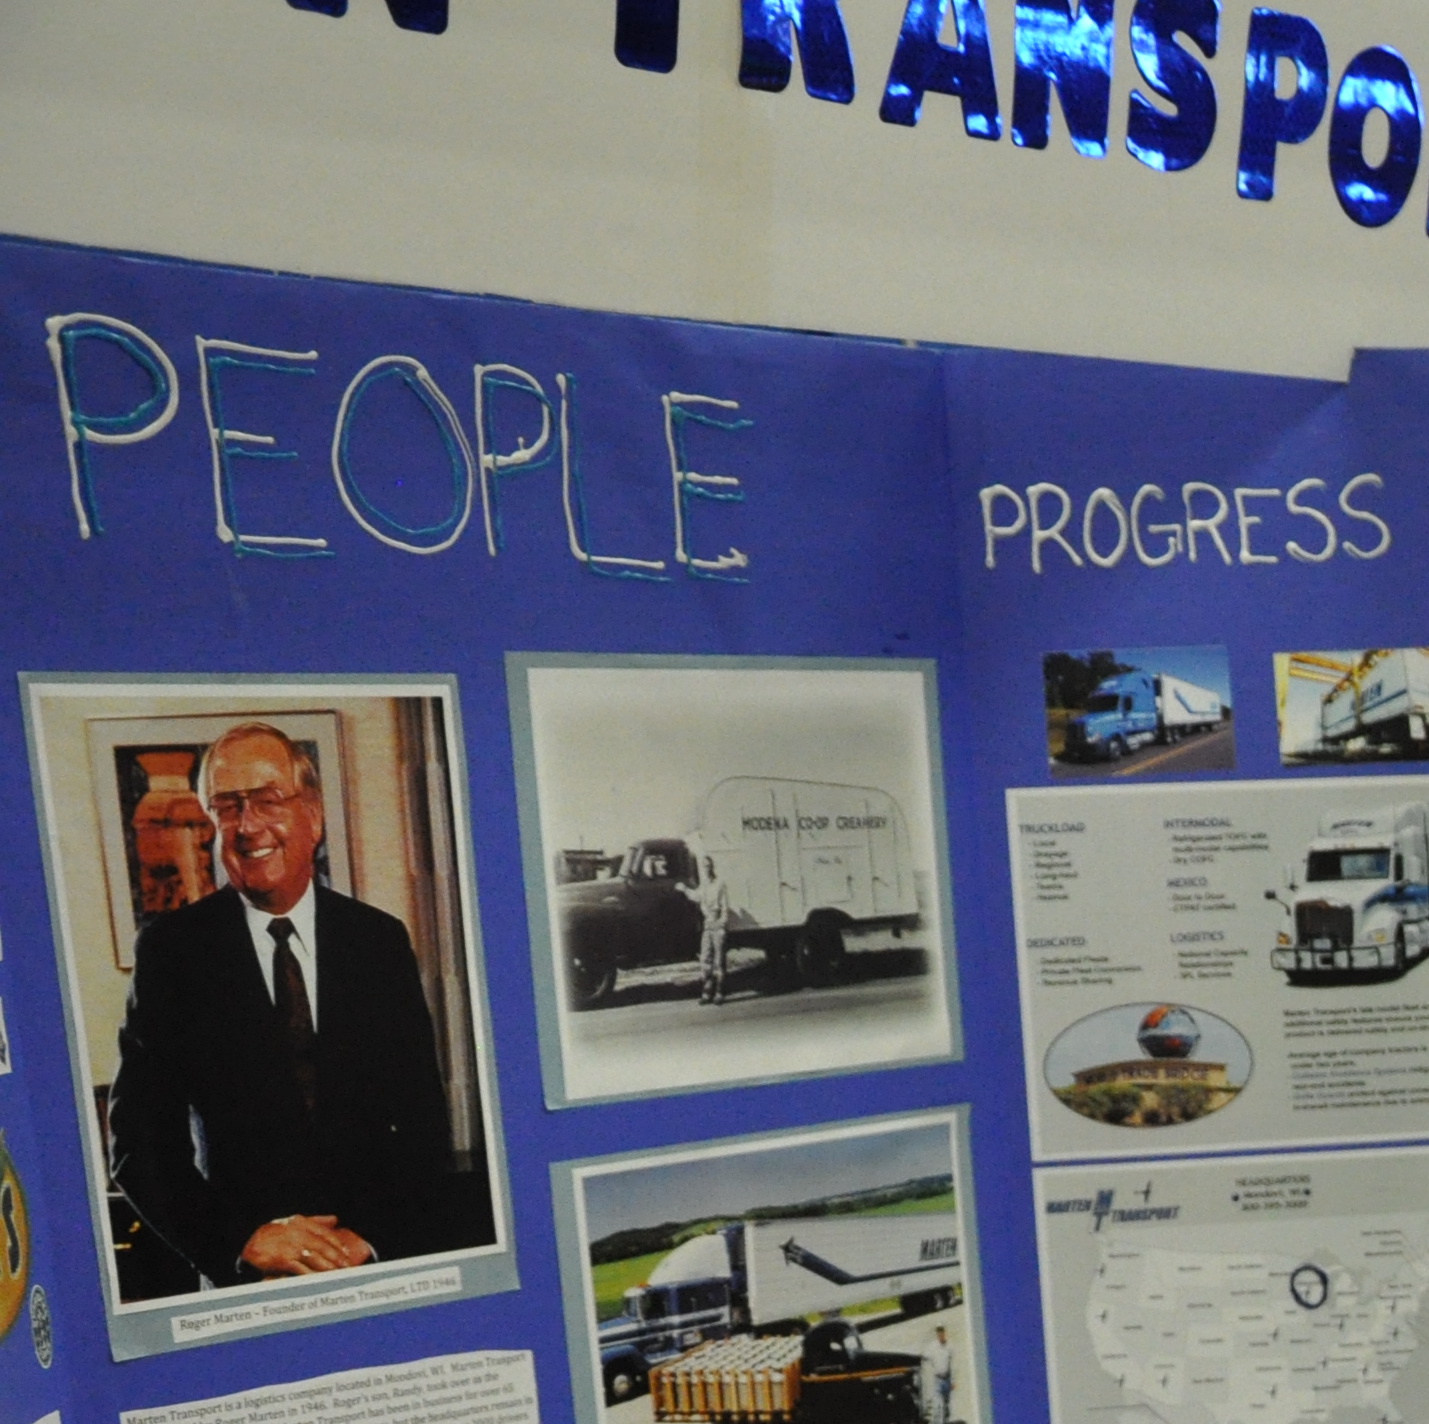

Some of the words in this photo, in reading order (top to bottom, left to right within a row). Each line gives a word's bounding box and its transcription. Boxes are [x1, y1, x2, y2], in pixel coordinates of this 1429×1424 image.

[46, 313, 754, 584] PEOPLE
[979, 473, 1393, 573] PROGRESS
[179, 1318, 210, 1330] Roger
[214, 1311, 251, 1323] Marten
[262, 1303, 304, 1316] Founder
[308, 1300, 317, 1308] of
[320, 1295, 355, 1305] Marten
[170, 1404, 221, 1420] Transport
[224, 1403, 233, 1411] is
[235, 1401, 242, 1409] a
[244, 1394, 285, 1408] logistics
[288, 1386, 332, 1400] company
[335, 1378, 370, 1391] located
[248, 1410, 284, 1421] Marten
[287, 1408, 297, 1416] in
[317, 1411, 365, 1424] Transport
